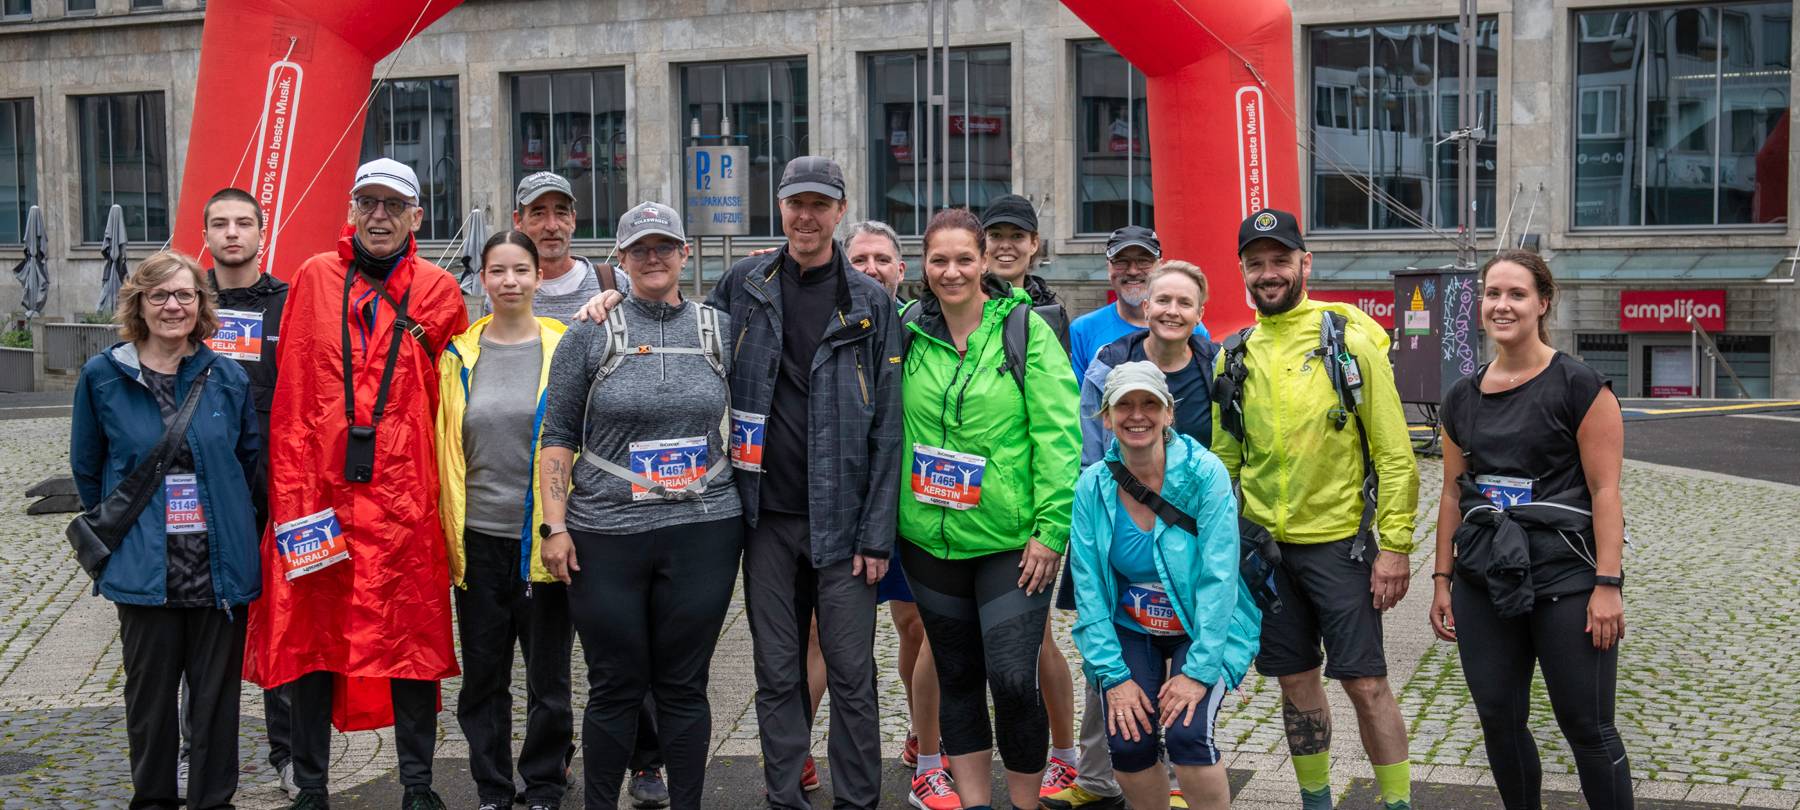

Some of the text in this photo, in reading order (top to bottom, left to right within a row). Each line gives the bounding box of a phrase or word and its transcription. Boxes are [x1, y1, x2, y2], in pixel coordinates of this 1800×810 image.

[275, 77, 291, 114] Musik.
[270, 117, 285, 150] beste
[267, 152, 279, 168] die
[1246, 99, 1260, 214] 00% die beste Musik.
[261, 171, 276, 206] 100%
[1624, 299, 1720, 323] amplifon
[215, 330, 237, 340] 008
[212, 341, 236, 350] FELIX
[660, 465, 684, 476] 1467
[655, 478, 693, 488] DRIANE
[932, 474, 954, 487] 1465
[924, 485, 960, 499] KERSTIN
[170, 501, 197, 510] 3149
[168, 513, 200, 521] PETRA
[295, 541, 319, 555] 7777
[292, 549, 329, 567] HARALD
[1148, 606, 1173, 617] 1579
[1151, 618, 1168, 628] UTE
